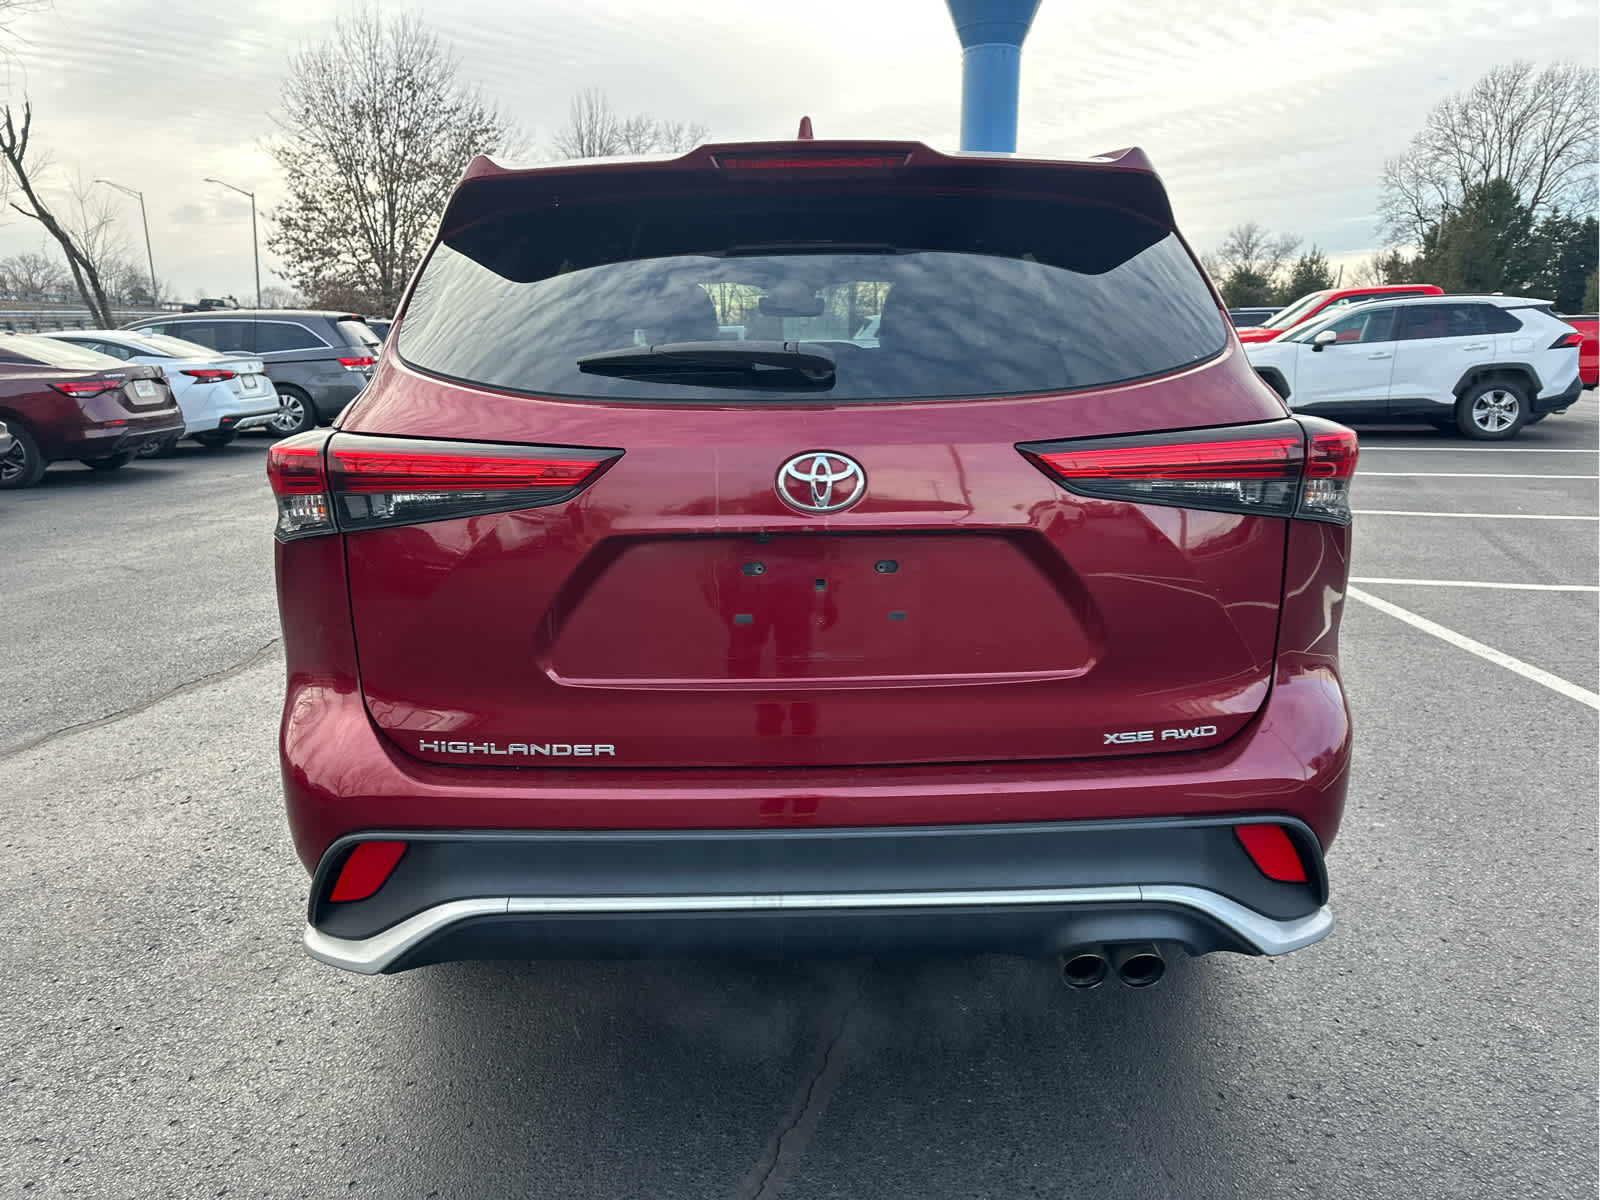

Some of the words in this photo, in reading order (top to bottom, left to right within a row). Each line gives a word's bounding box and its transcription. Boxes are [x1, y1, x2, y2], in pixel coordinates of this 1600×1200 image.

[1103, 730, 1154, 745] XSE
[1161, 725, 1217, 741] AWD
[419, 739, 616, 756] HIGHLANDER
